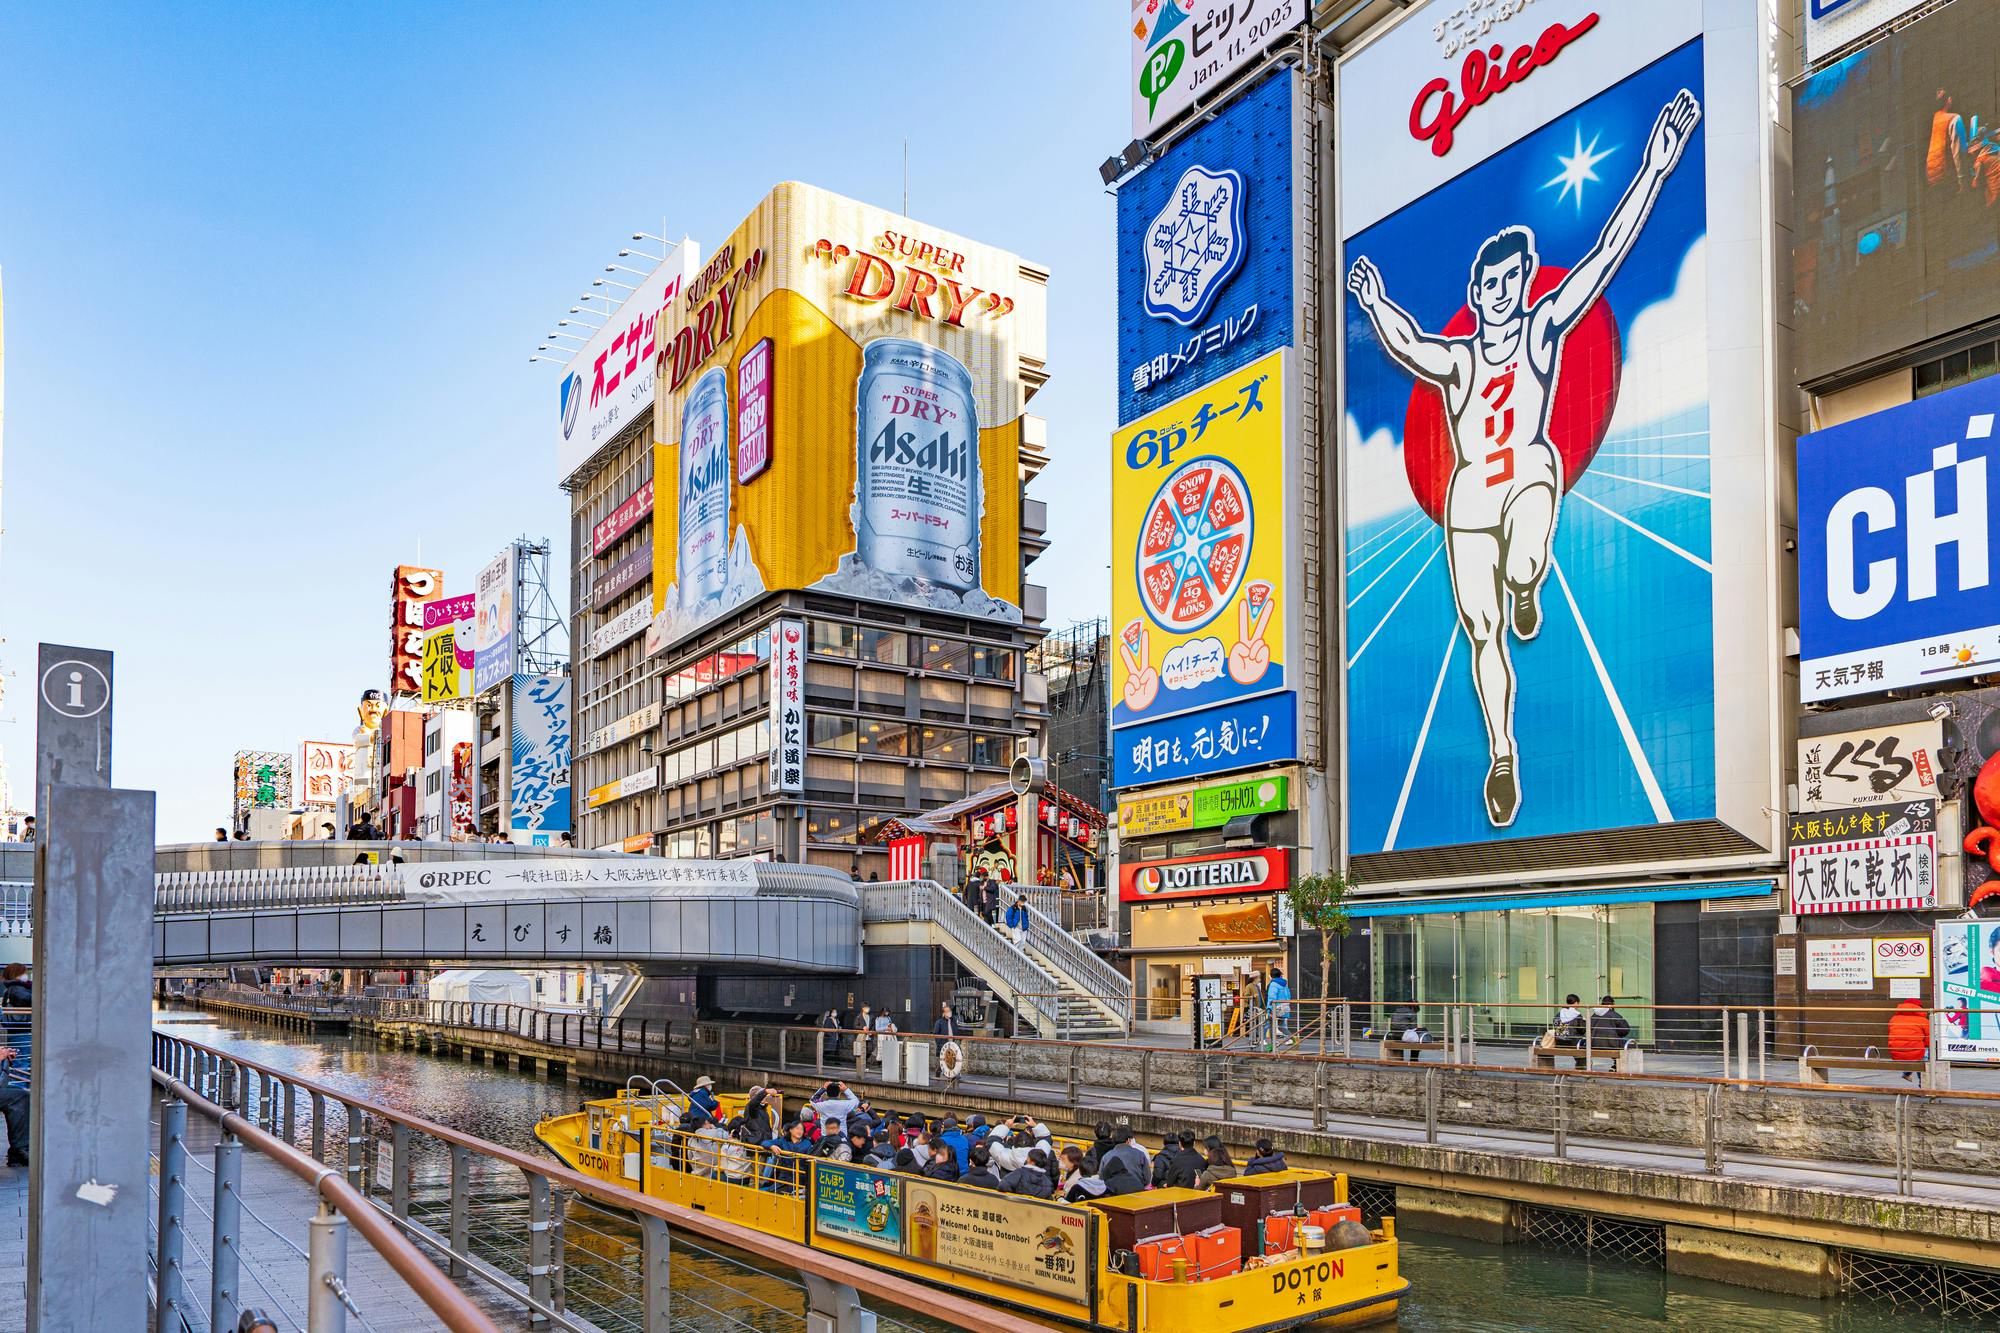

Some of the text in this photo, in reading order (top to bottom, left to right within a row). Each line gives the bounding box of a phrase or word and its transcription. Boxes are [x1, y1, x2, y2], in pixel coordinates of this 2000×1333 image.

[1189, 0, 1293, 91] Jan. 11, 2023
[881, 230, 966, 273] SUPER
[686, 245, 733, 312] SUPER
[1132, 303, 1258, 392] 雪印メグミルク
[739, 350, 767, 398] ASAHI
[902, 385, 939, 402] SUPER
[739, 395, 767, 439] 1889
[1481, 362, 1518, 488] グリコ
[739, 431, 766, 477] OSAKA
[870, 417, 967, 481] Asahi
[684, 441, 724, 513] Asahi
[907, 475, 932, 498] 生
[1178, 472, 1206, 493] SNOW
[1220, 483, 1242, 516] SNOW
[891, 509, 949, 530] スーパードライ
[1147, 508, 1165, 548] SNOW
[1222, 544, 1240, 586] SNOW
[594, 584, 603, 605] 7F
[1146, 574, 1165, 606] SNOW
[1178, 601, 1206, 619] SNOW
[440, 633, 454, 697] 高収入
[1921, 643, 1951, 657] 18時
[425, 635, 440, 700] バイト
[785, 647, 799, 703] 本場の味
[1815, 660, 1884, 690] 天気予報
[784, 707, 801, 786] かに道楽
[1804, 743, 1823, 802] 道頓堀
[1823, 736, 1914, 794] くくる
[1220, 786, 1256, 812] ピタットハウス
[1852, 794, 1884, 804] KUKURU
[1791, 811, 1890, 841] 大阪もんを食す
[1912, 818, 1932, 833] 2F
[420, 869, 491, 889] ORPEC
[505, 868, 599, 883] 一般社団法人
[1164, 860, 1256, 889] LOTTERIA
[1797, 849, 1913, 902] 大阪に乾杯
[1918, 853, 1929, 886] 検索
[471, 922, 613, 945] えびす橋
[578, 1152, 609, 1172] DOTON
[966, 1208, 979, 1219] 大阪
[1061, 1215, 1084, 1228] KIRIN
[940, 1217, 1031, 1244] Welcome! Osaka Dotonbori
[1034, 1253, 1076, 1275] 一番搾り
[1035, 1268, 1077, 1285] KIRIN ICHIBAN
[1272, 1258, 1345, 1295] DOTON
